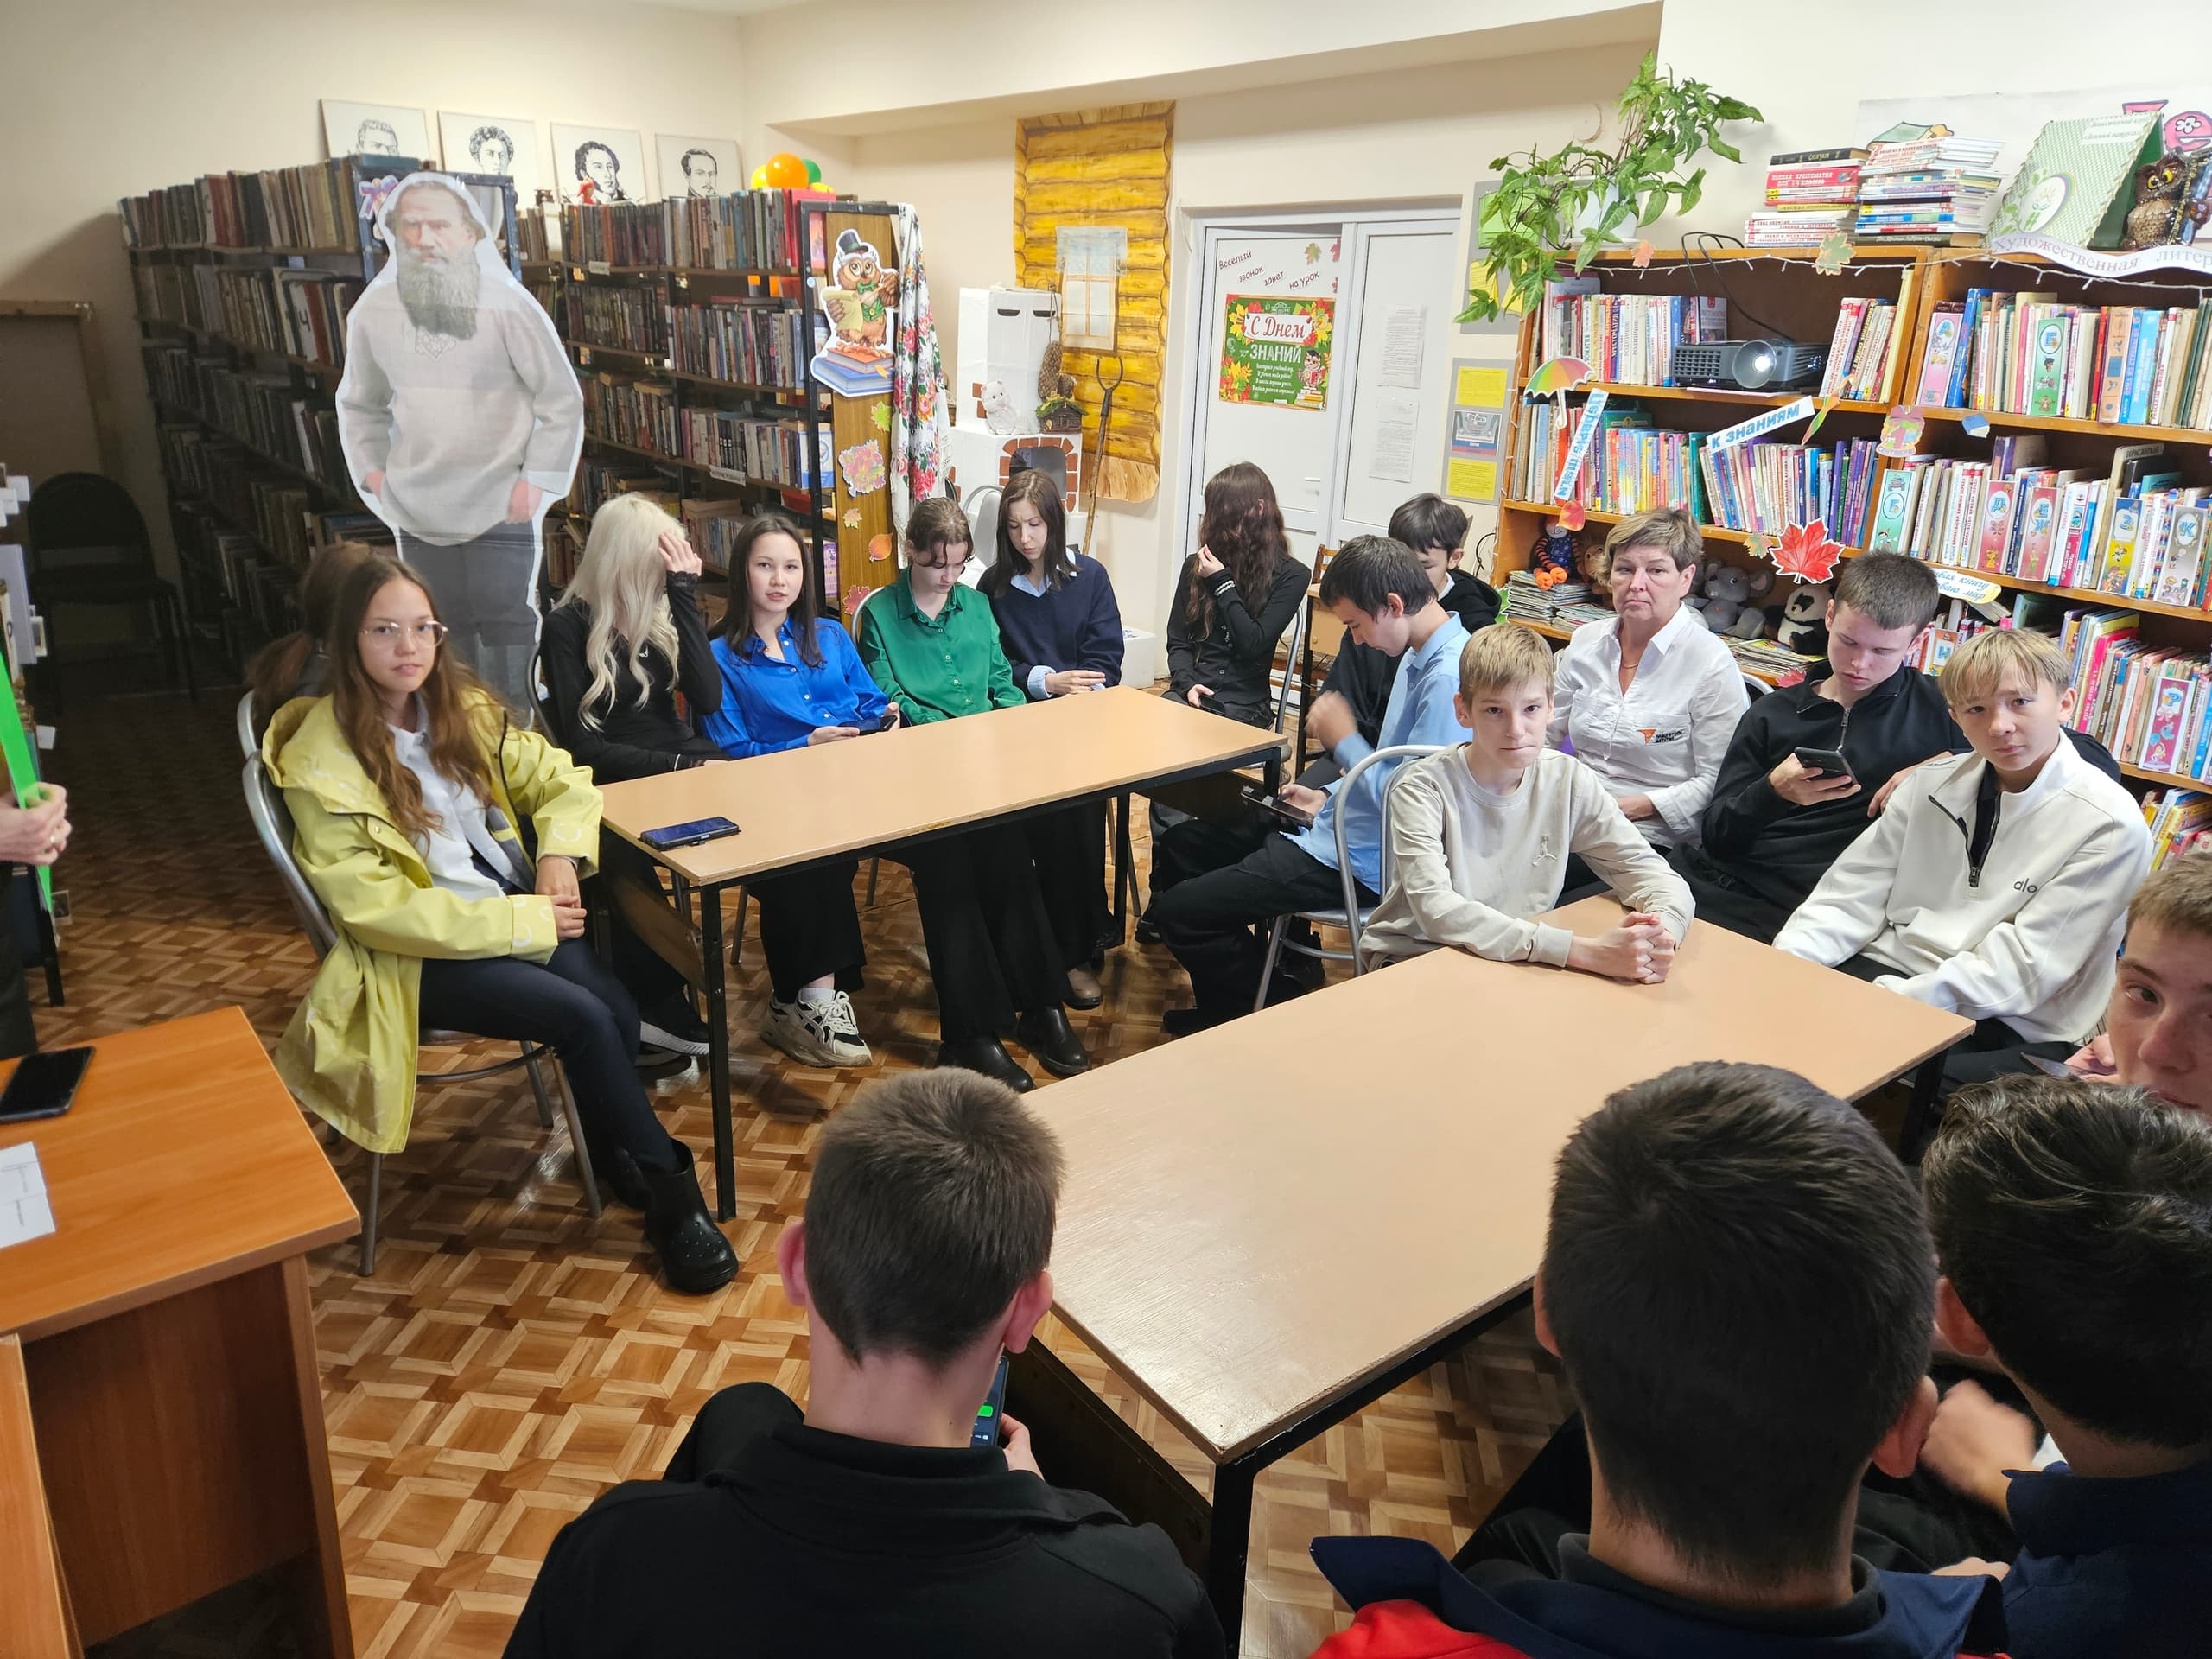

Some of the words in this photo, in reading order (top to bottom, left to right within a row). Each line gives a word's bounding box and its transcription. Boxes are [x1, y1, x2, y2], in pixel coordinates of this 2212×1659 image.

[1218, 250, 1252, 270] Веселый
[1993, 238, 2139, 271] Художественная
[1239, 266, 1263, 283] звонок
[1264, 271, 1284, 287] зовет
[1289, 279, 1299, 289] на
[1300, 271, 1319, 288] урок
[1250, 315, 1261, 335] С
[1263, 316, 1306, 339] Днем
[1249, 344, 1302, 364] ЗНАНИЙ
[1573, 393, 1605, 454] Первые
[1726, 404, 1800, 443] знаниям
[1557, 458, 1579, 497] шаги
[1959, 576, 1990, 591] книгу
[2167, 692, 2183, 707] Р
[2013, 877, 2037, 893] alo
